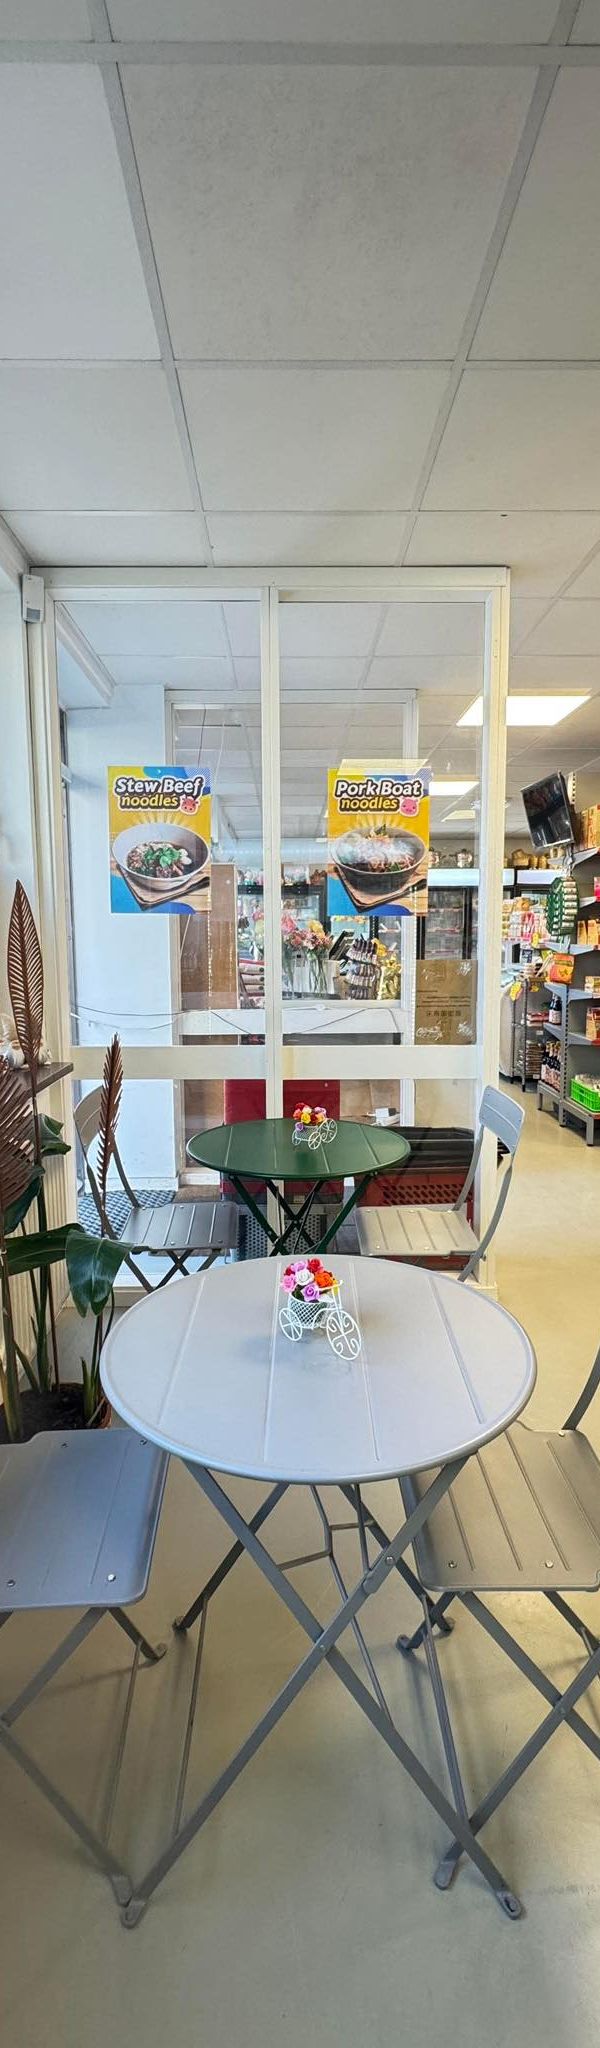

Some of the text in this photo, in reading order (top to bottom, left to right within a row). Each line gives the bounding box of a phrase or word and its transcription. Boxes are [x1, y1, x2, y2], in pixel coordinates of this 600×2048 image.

[115, 777, 202, 796] Stew Beef
[336, 779, 421, 796] Pork Boat
[120, 793, 179, 807] noodles
[340, 796, 398, 810] noodles
